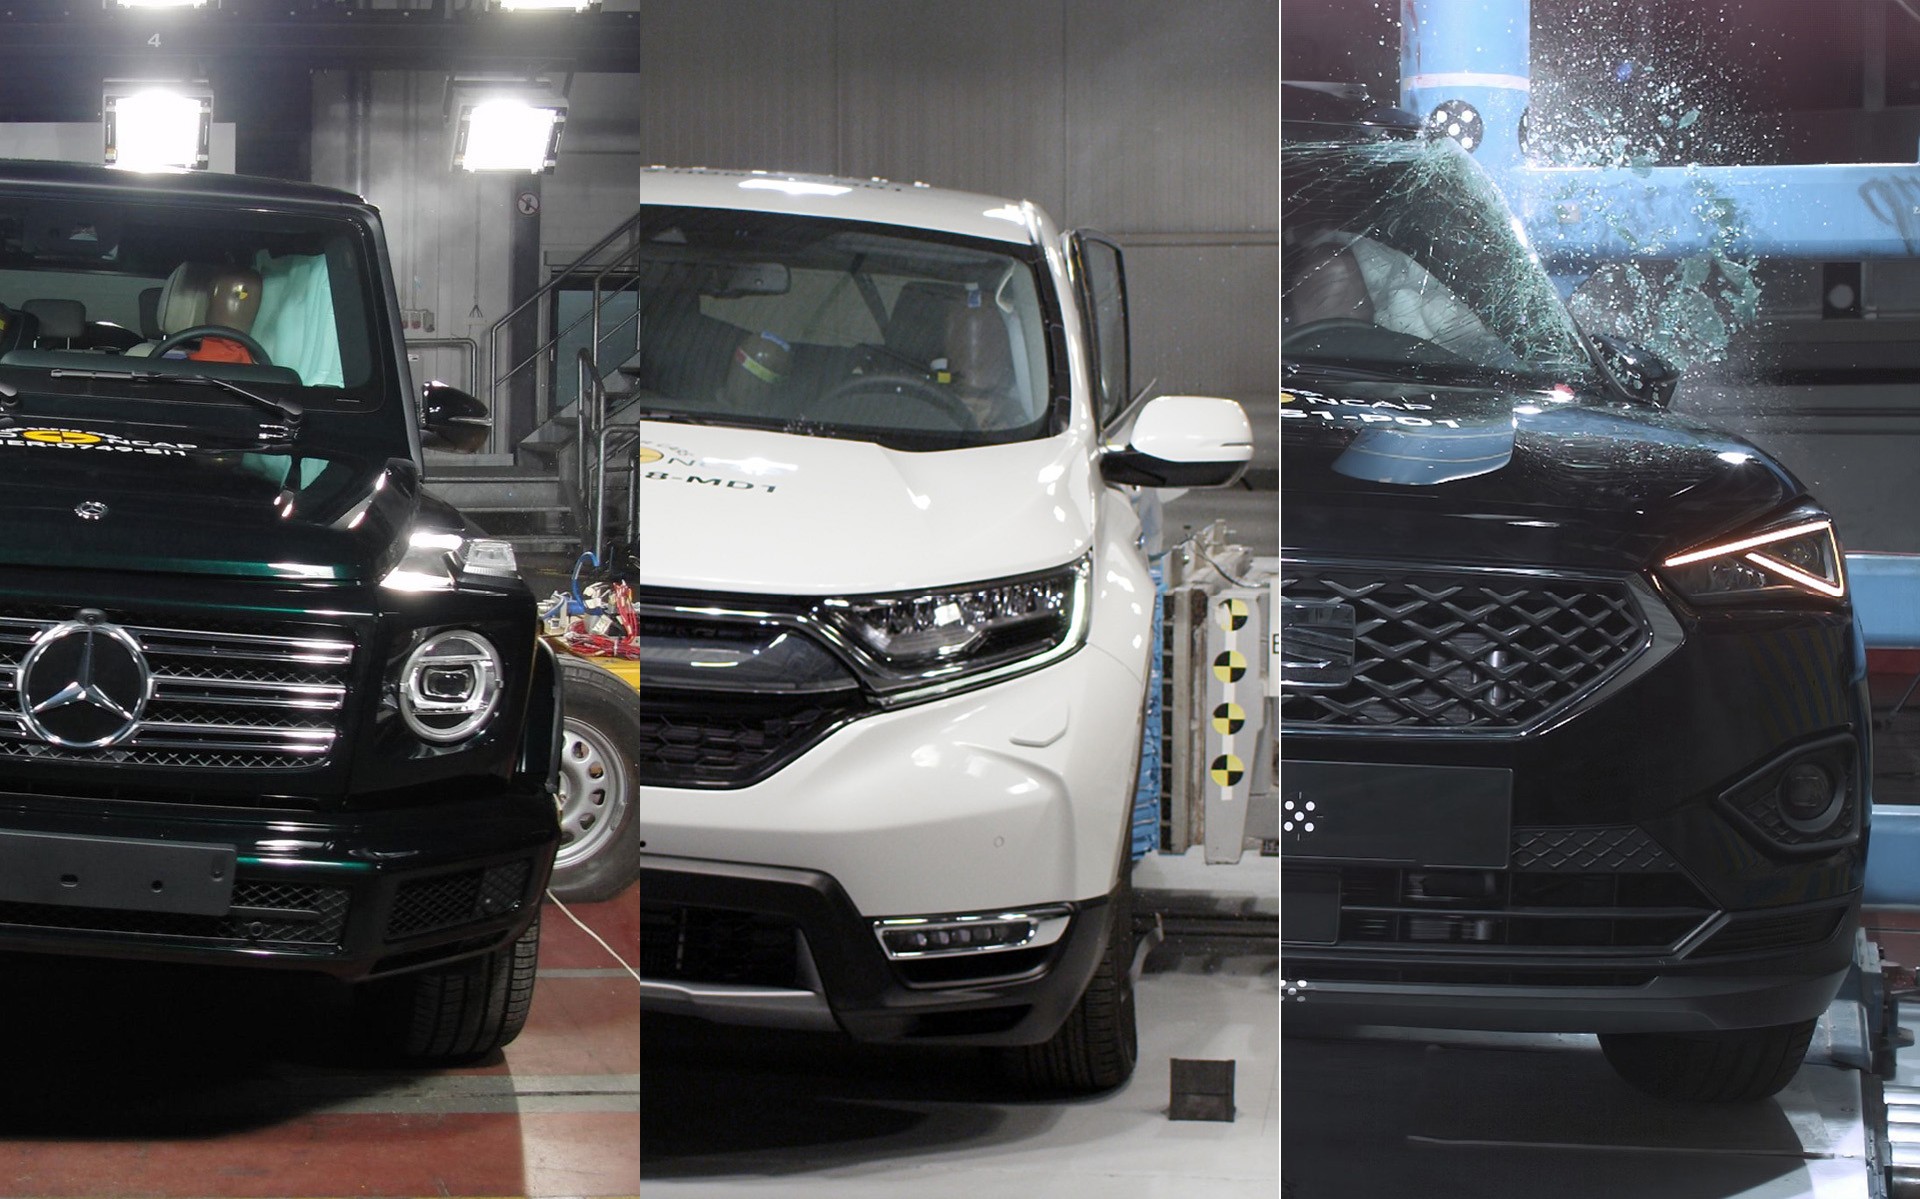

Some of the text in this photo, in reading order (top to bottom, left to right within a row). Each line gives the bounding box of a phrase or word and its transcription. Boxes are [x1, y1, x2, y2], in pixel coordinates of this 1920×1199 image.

[147, 33, 162, 48] 4
[1306, 396, 1433, 411] NCAP
[107, 438, 197, 450] NCAP
